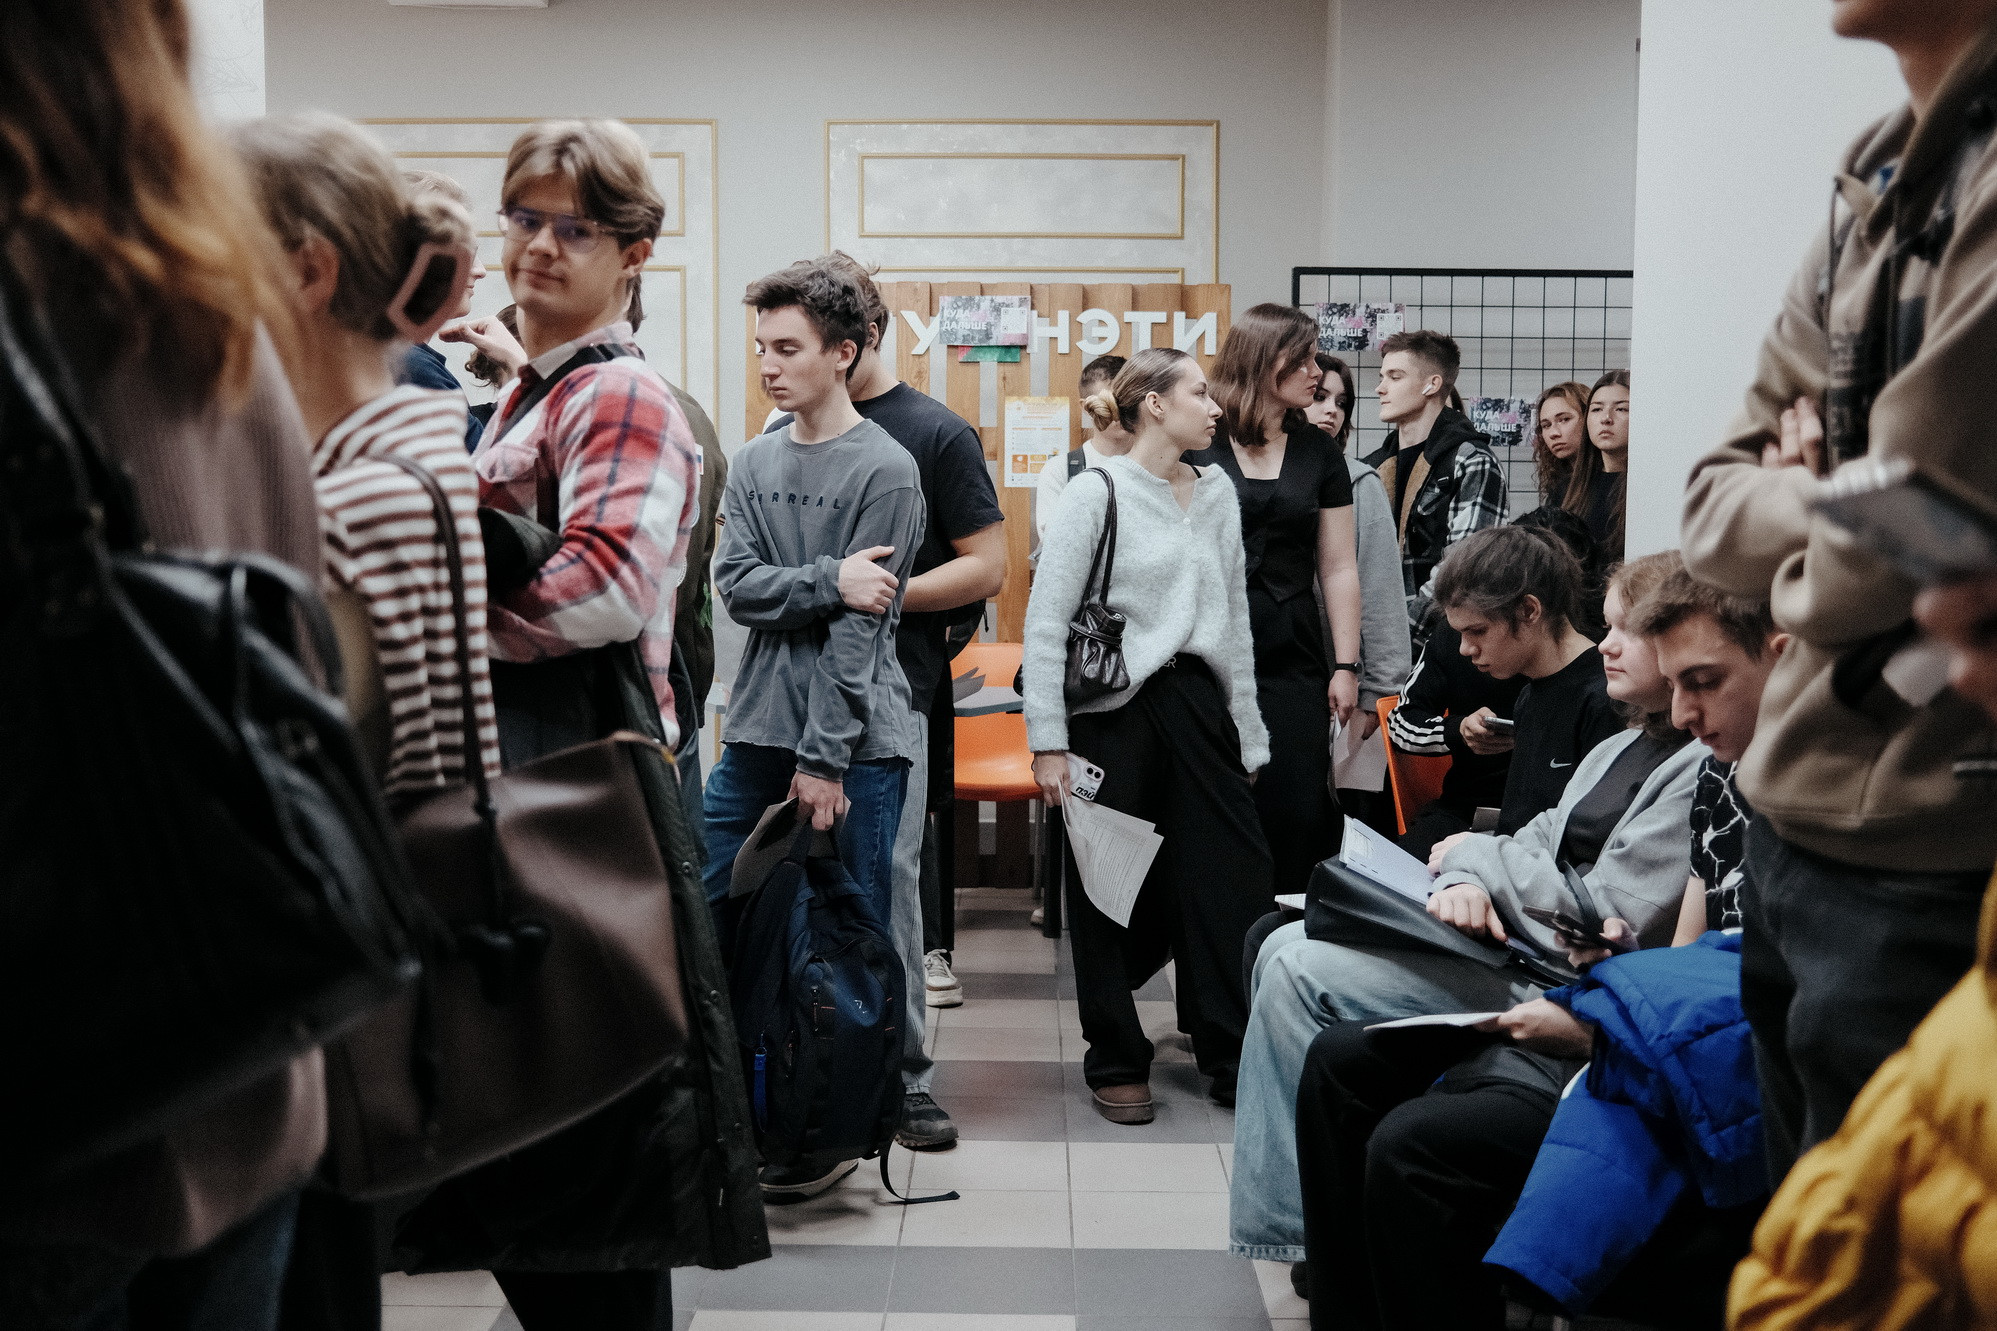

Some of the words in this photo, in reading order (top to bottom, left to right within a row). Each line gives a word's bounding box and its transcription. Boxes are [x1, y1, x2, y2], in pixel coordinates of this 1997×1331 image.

[943, 309, 970, 319] КУДА
[942, 320, 988, 331] ДАЛЬШЕ
[1319, 316, 1346, 327] КУДА
[1027, 308, 1217, 355] НЭТИ
[1319, 328, 1363, 338] ДАЛЬШЕ
[1473, 411, 1500, 421] КУДА
[1473, 423, 1517, 433] ДАЛЬШЕ
